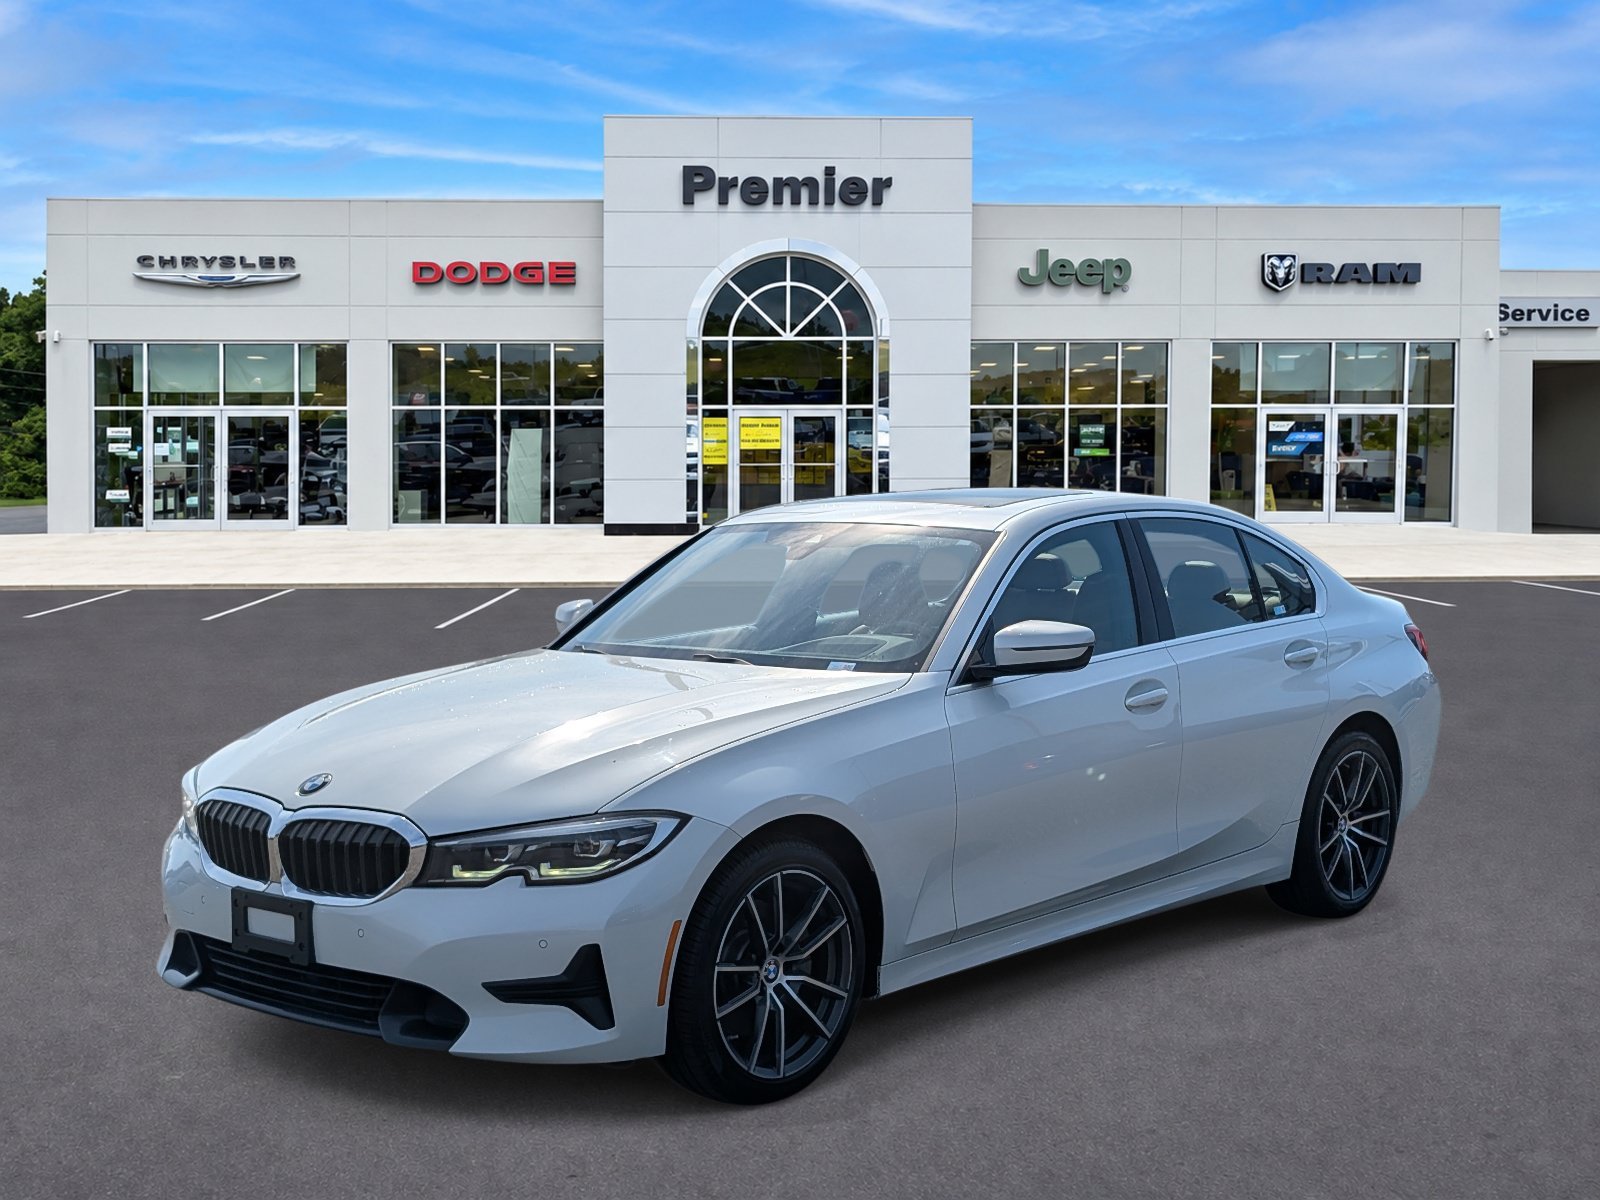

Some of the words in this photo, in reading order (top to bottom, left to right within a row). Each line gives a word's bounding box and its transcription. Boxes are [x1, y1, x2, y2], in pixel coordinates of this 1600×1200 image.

[682, 165, 893, 206] Premier
[136, 255, 297, 269] CHRYSLER
[412, 261, 577, 285] DODGE
[1017, 248, 1132, 294] Jeep
[1301, 262, 1422, 284] RAM
[1499, 303, 1590, 322] Service
